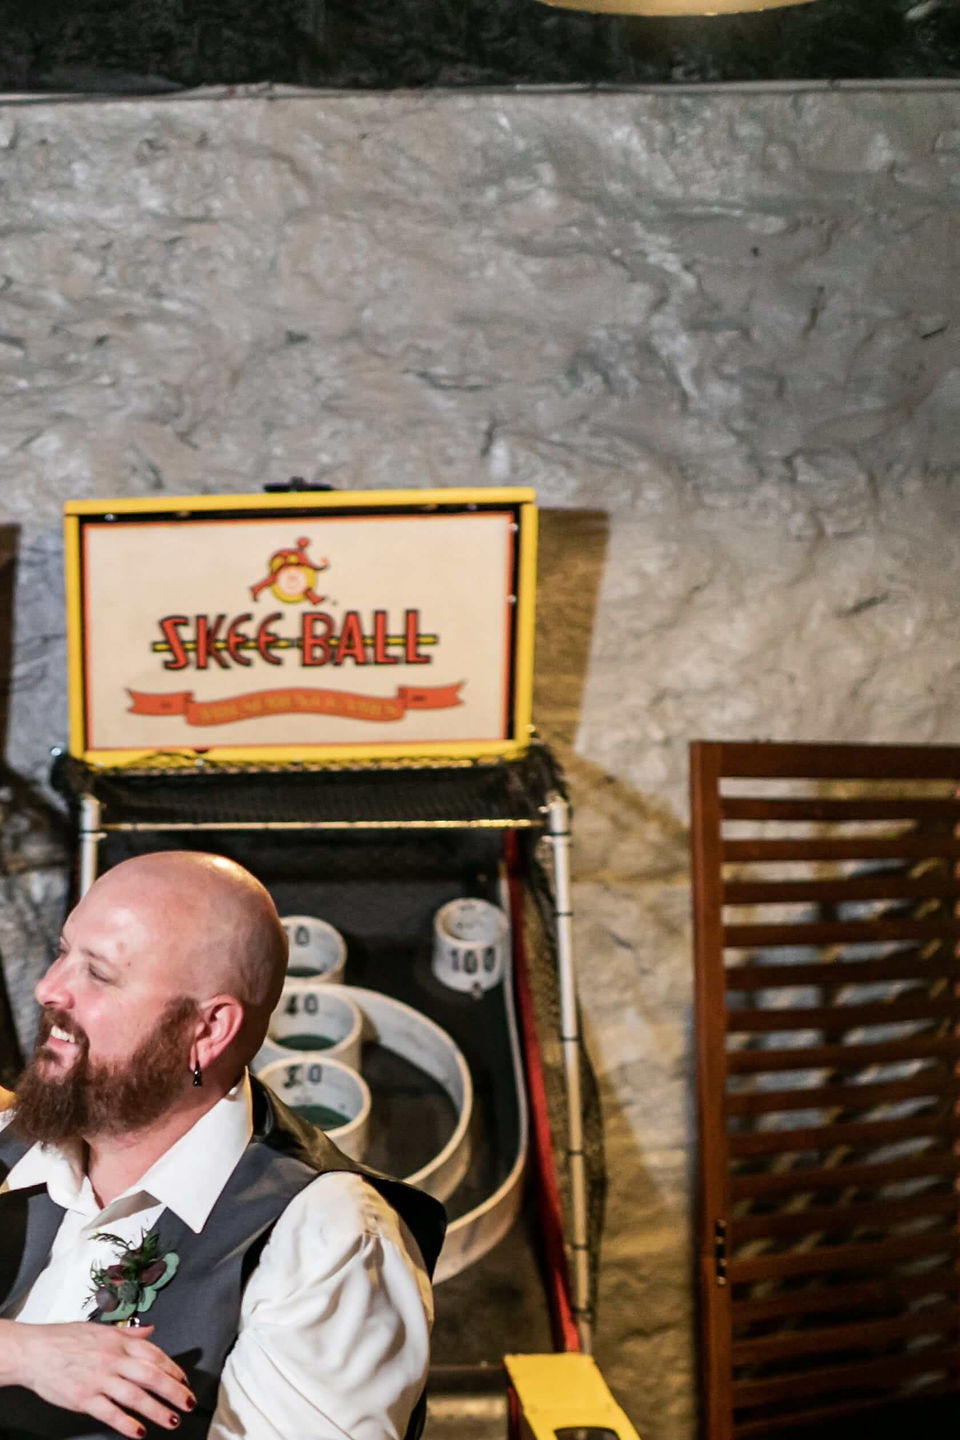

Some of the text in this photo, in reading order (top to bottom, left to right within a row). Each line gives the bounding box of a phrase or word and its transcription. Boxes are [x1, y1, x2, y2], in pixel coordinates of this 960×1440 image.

[158, 609, 433, 671] SKEE BALL
[451, 946, 496, 976] 100
